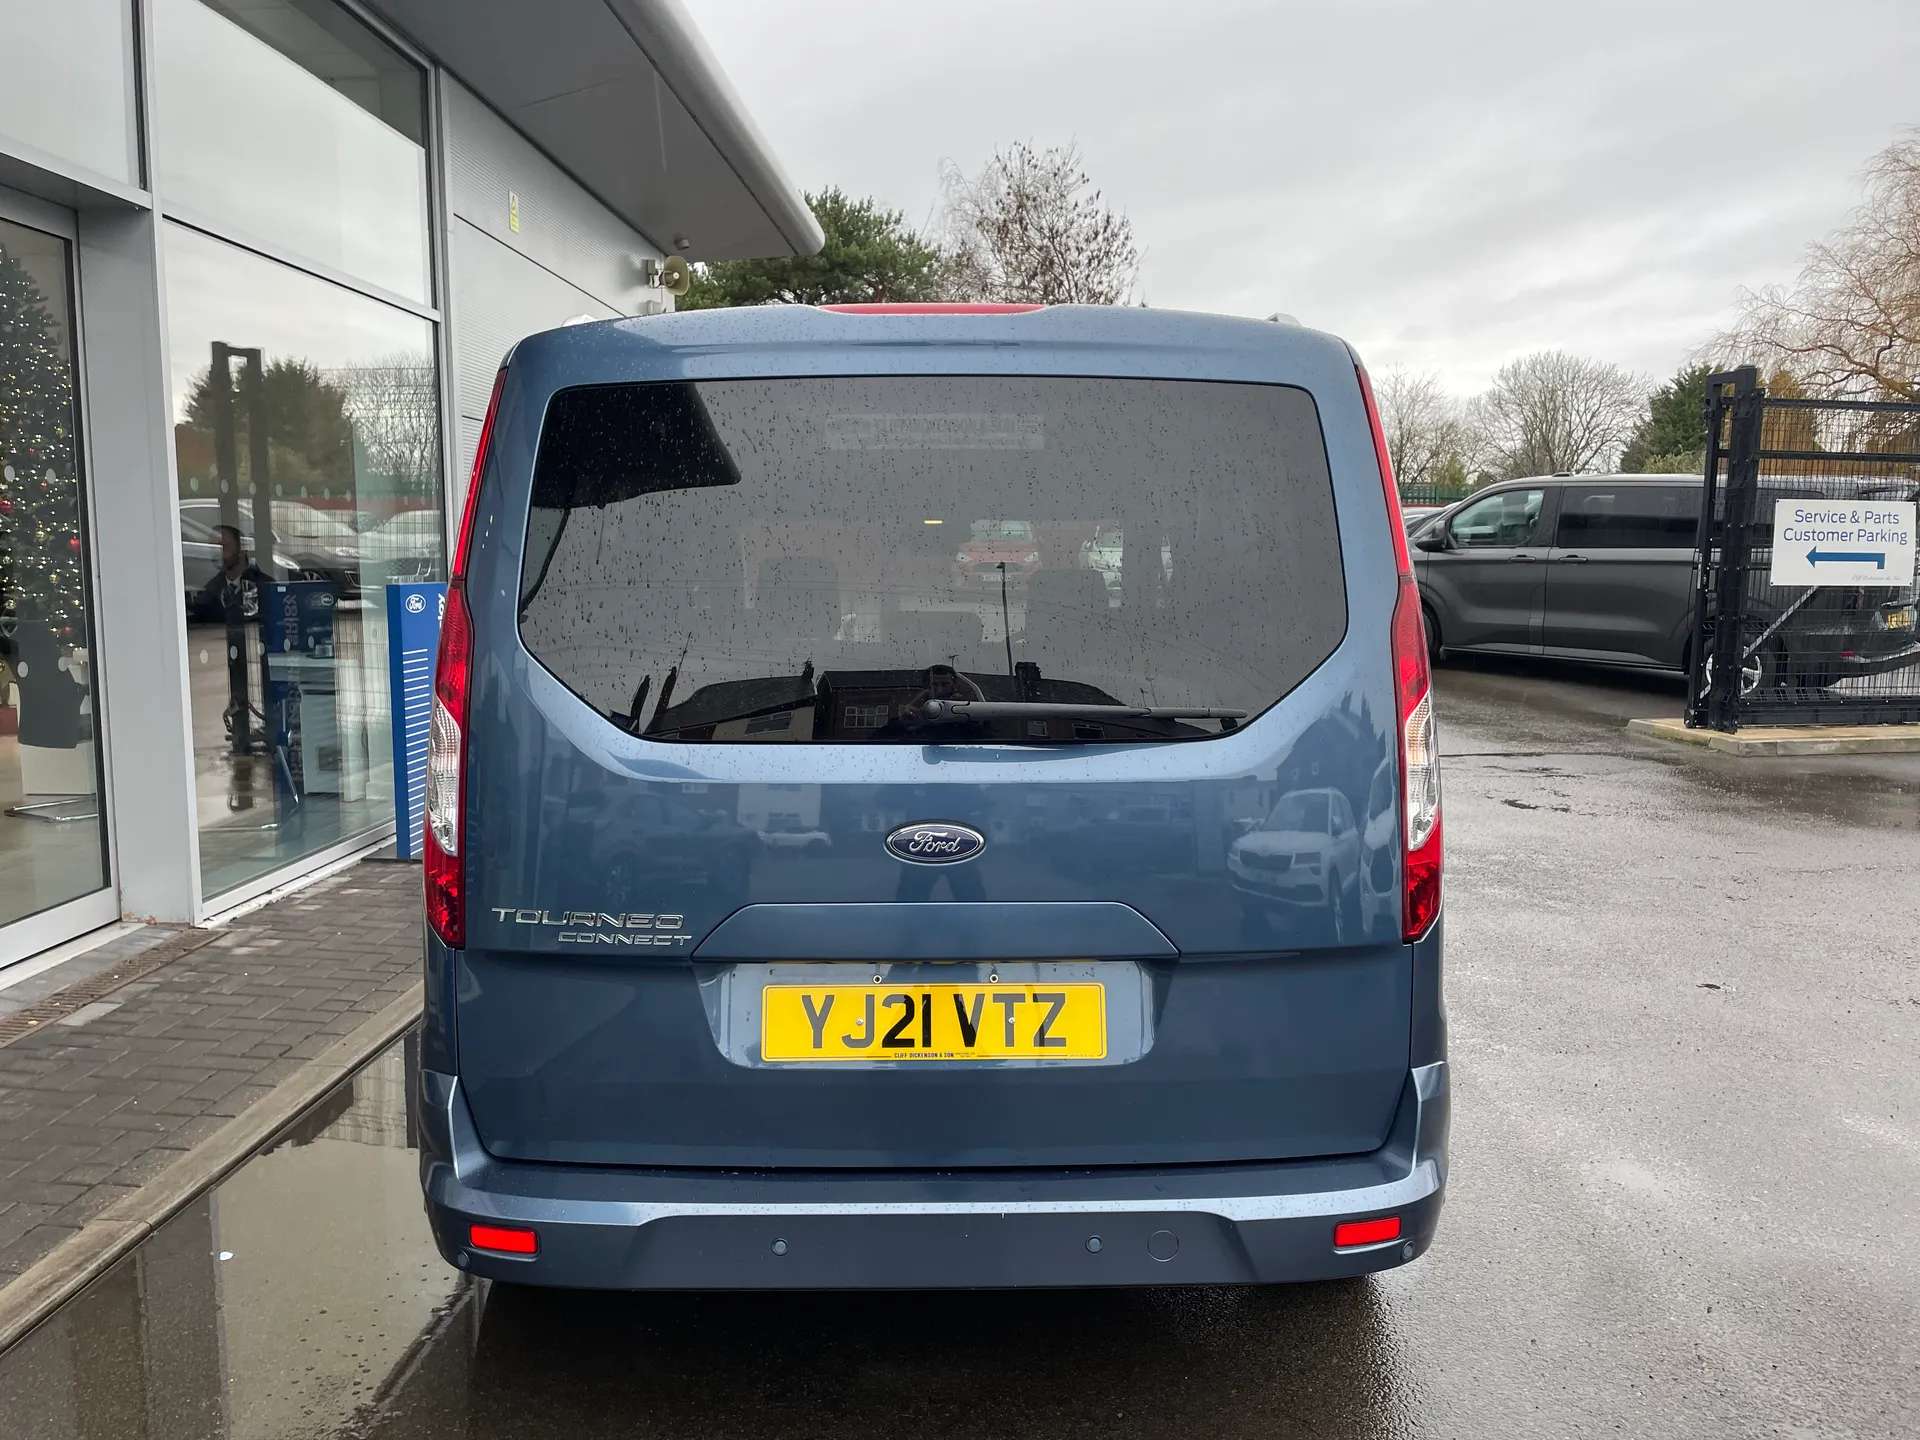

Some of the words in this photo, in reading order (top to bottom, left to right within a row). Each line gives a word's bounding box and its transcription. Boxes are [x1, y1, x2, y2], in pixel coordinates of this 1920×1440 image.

[1794, 509, 1847, 524] Service
[1849, 510, 1860, 524] &
[1864, 510, 1899, 525] Parts
[1783, 527, 1853, 542] Customer
[1857, 528, 1908, 546] Parking
[908, 830, 961, 853] Ford
[491, 907, 684, 929] TOURNEO
[558, 931, 692, 947] CONNECT
[801, 993, 932, 1049] YJ21
[953, 993, 1067, 1049] VTZ
